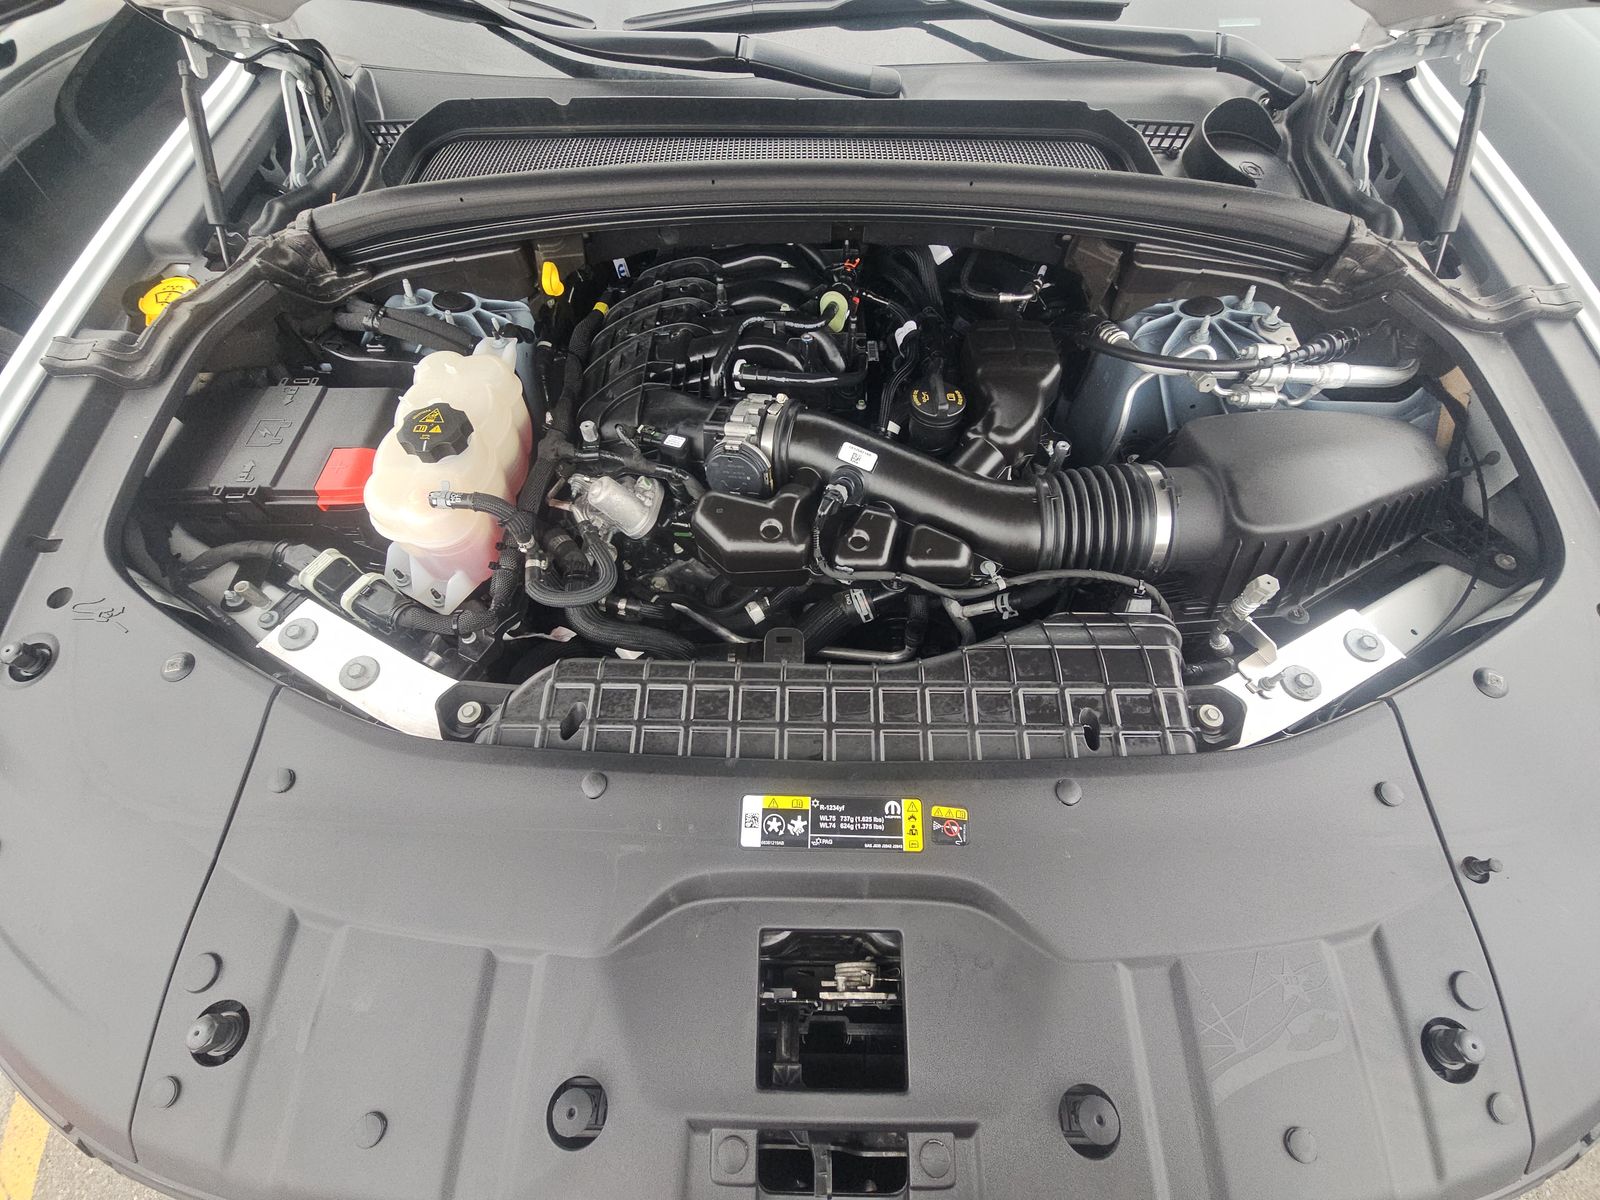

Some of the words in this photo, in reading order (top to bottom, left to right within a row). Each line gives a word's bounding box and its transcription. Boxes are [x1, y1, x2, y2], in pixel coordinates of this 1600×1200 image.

[819, 804, 845, 812] R-1234yf
[840, 815, 854, 823] 737g
[873, 816, 885, 824] lbs)
[840, 823, 854, 831] 624g
[855, 823, 872, 831] (1.375
